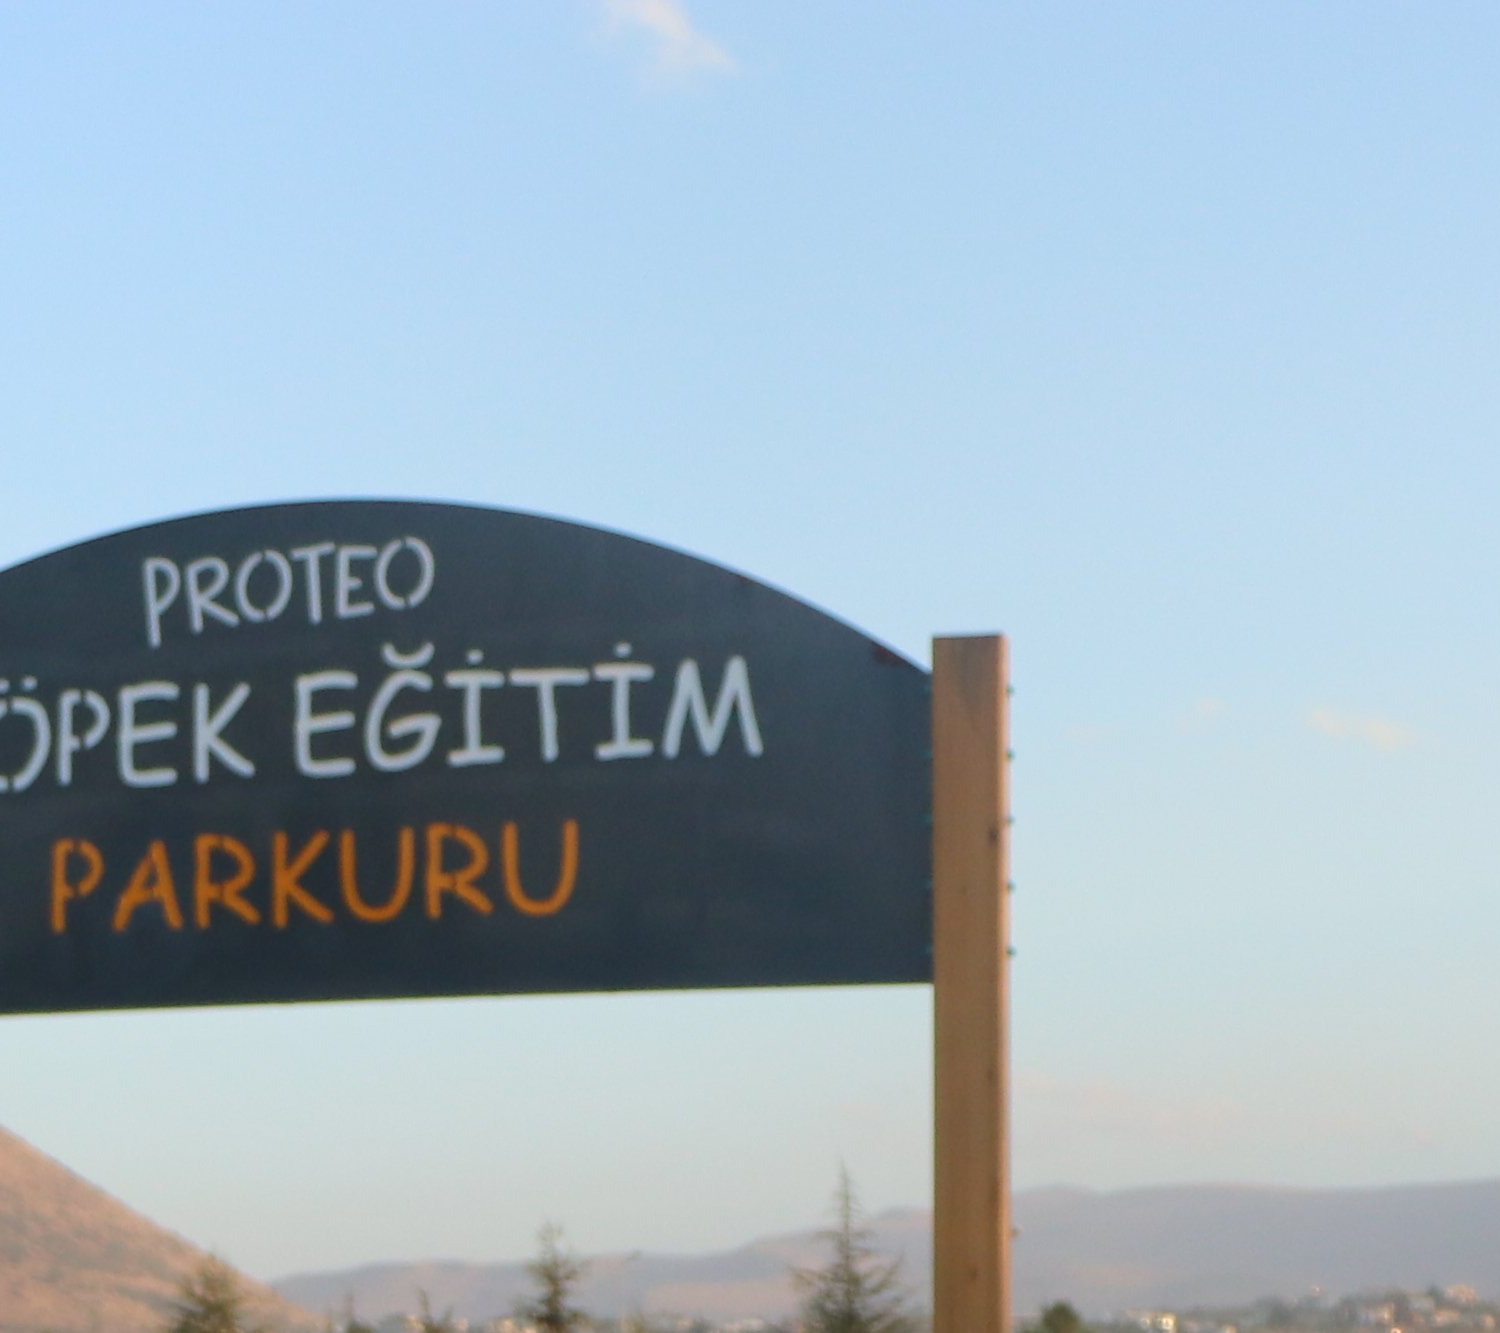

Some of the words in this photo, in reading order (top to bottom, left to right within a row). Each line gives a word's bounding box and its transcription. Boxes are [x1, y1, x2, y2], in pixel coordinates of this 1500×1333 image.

[142, 536, 435, 648] PROTEO
[294, 641, 764, 777] EĞİTİM
[50, 819, 579, 933] PARKURU
